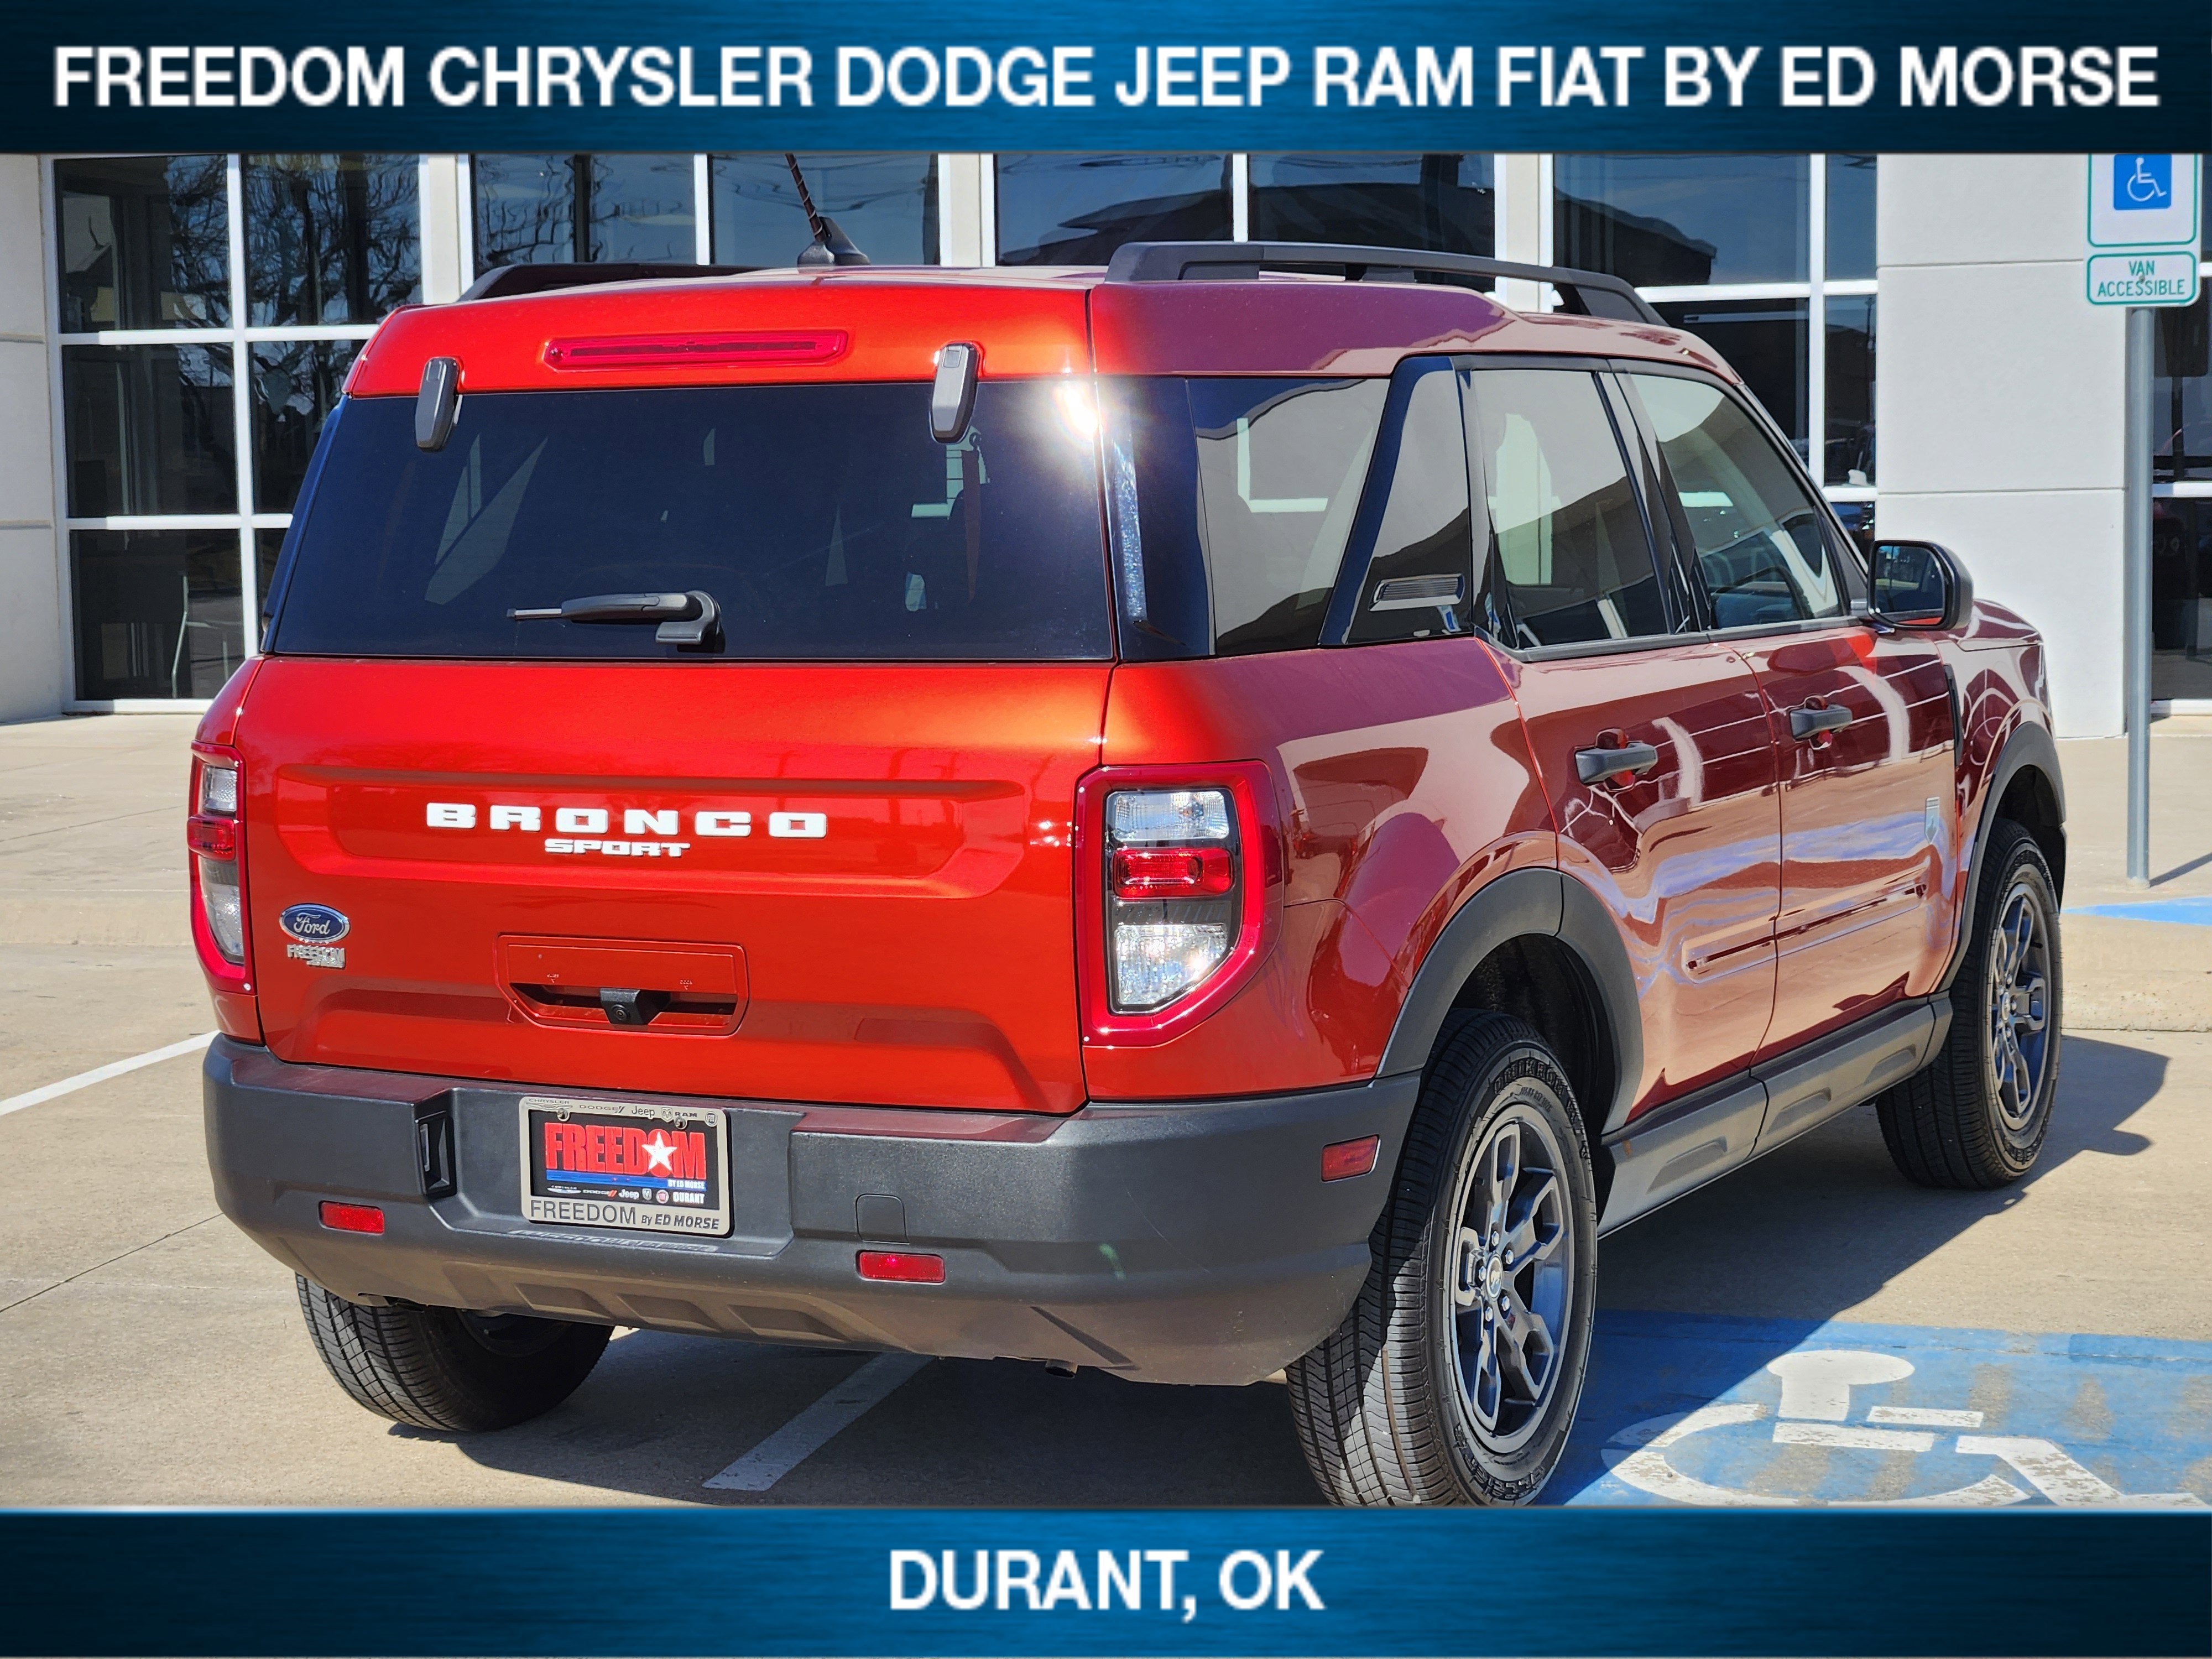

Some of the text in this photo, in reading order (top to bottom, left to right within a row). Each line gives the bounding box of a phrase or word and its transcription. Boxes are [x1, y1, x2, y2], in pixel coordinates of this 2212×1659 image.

[2128, 260, 2155, 276] VAN
[2098, 279, 2185, 297] ACCESSIBLE
[426, 802, 827, 838] BRONCO
[545, 838, 691, 857] SPORT
[293, 912, 331, 935] Ford
[631, 1105, 655, 1117] Jeep
[545, 1122, 707, 1180] FREEDOM
[618, 1188, 640, 1200] Jeep
[676, 1180, 685, 1188] ED
[685, 1180, 705, 1190] MORSE
[672, 1192, 705, 1204] DURANT
[530, 1199, 637, 1225] FREEDOM
[655, 1213, 671, 1225] ED
[674, 1215, 719, 1230] MORSE
